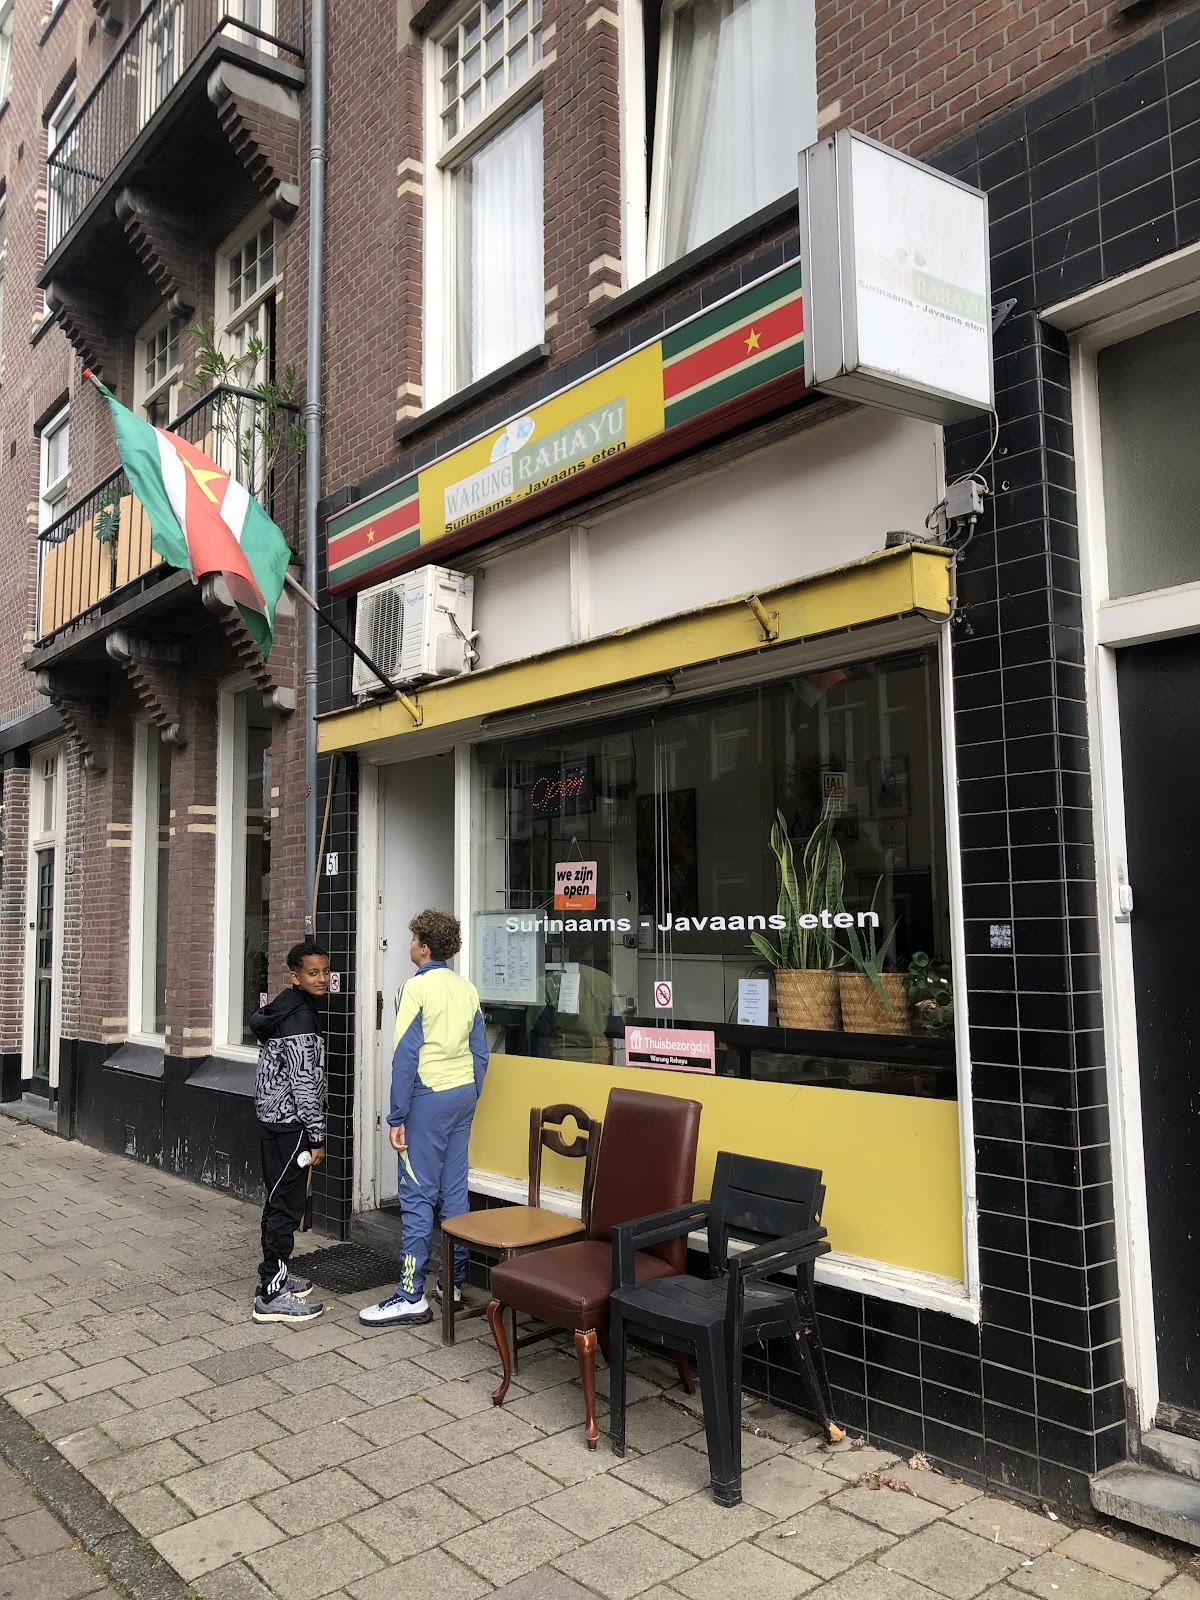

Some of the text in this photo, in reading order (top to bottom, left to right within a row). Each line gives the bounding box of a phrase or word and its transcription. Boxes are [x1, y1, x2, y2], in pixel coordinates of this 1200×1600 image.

[858, 280, 913, 307] Surinaams
[922, 305, 962, 324] Javaans
[965, 321, 985, 333] eten
[445, 407, 624, 514] WARUNG RAHAYU
[445, 497, 512, 533] Surinaams
[525, 461, 586, 496] Javaans
[592, 441, 627, 464] eten
[328, 854, 337, 875] 51
[557, 866, 593, 884] we zijn
[563, 885, 590, 899] open
[505, 915, 632, 933] Surinaams
[657, 912, 787, 931] Javaans
[799, 908, 880, 930] eten
[644, 1036, 711, 1055] Thuisbezorgd.nl
[650, 1055, 688, 1066] Warung Rahayu
